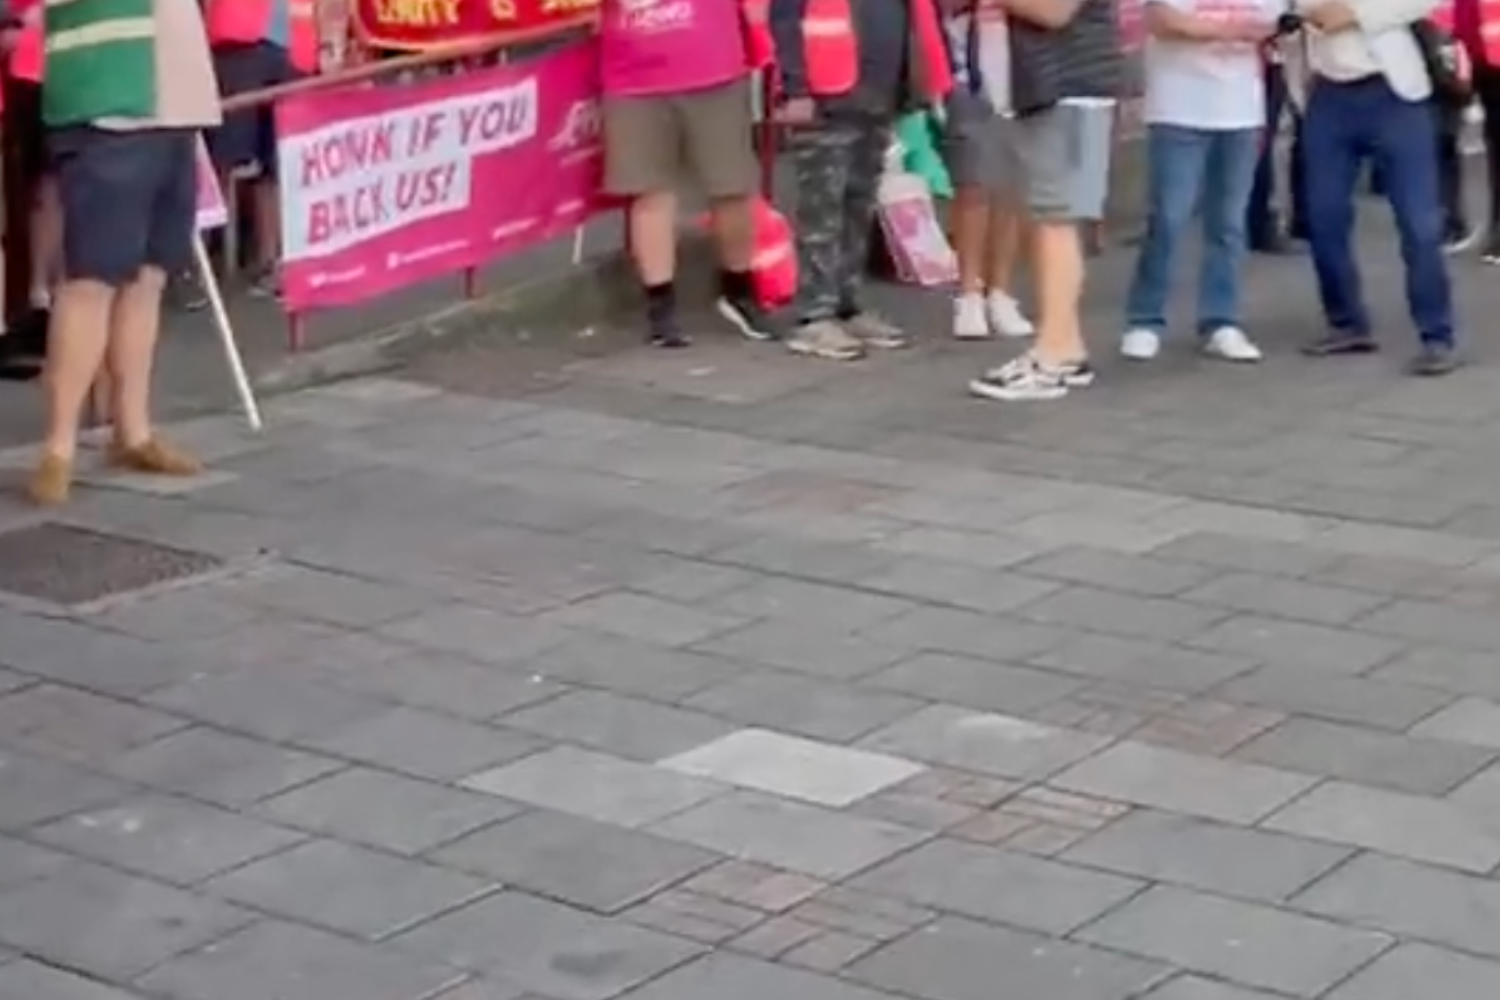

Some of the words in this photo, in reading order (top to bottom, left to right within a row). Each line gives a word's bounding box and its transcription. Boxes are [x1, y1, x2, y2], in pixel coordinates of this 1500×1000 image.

[299, 122, 395, 186] HONK
[404, 111, 446, 157] IF
[458, 95, 528, 147] YOU
[307, 182, 391, 246] BACK
[396, 161, 457, 212] US!
